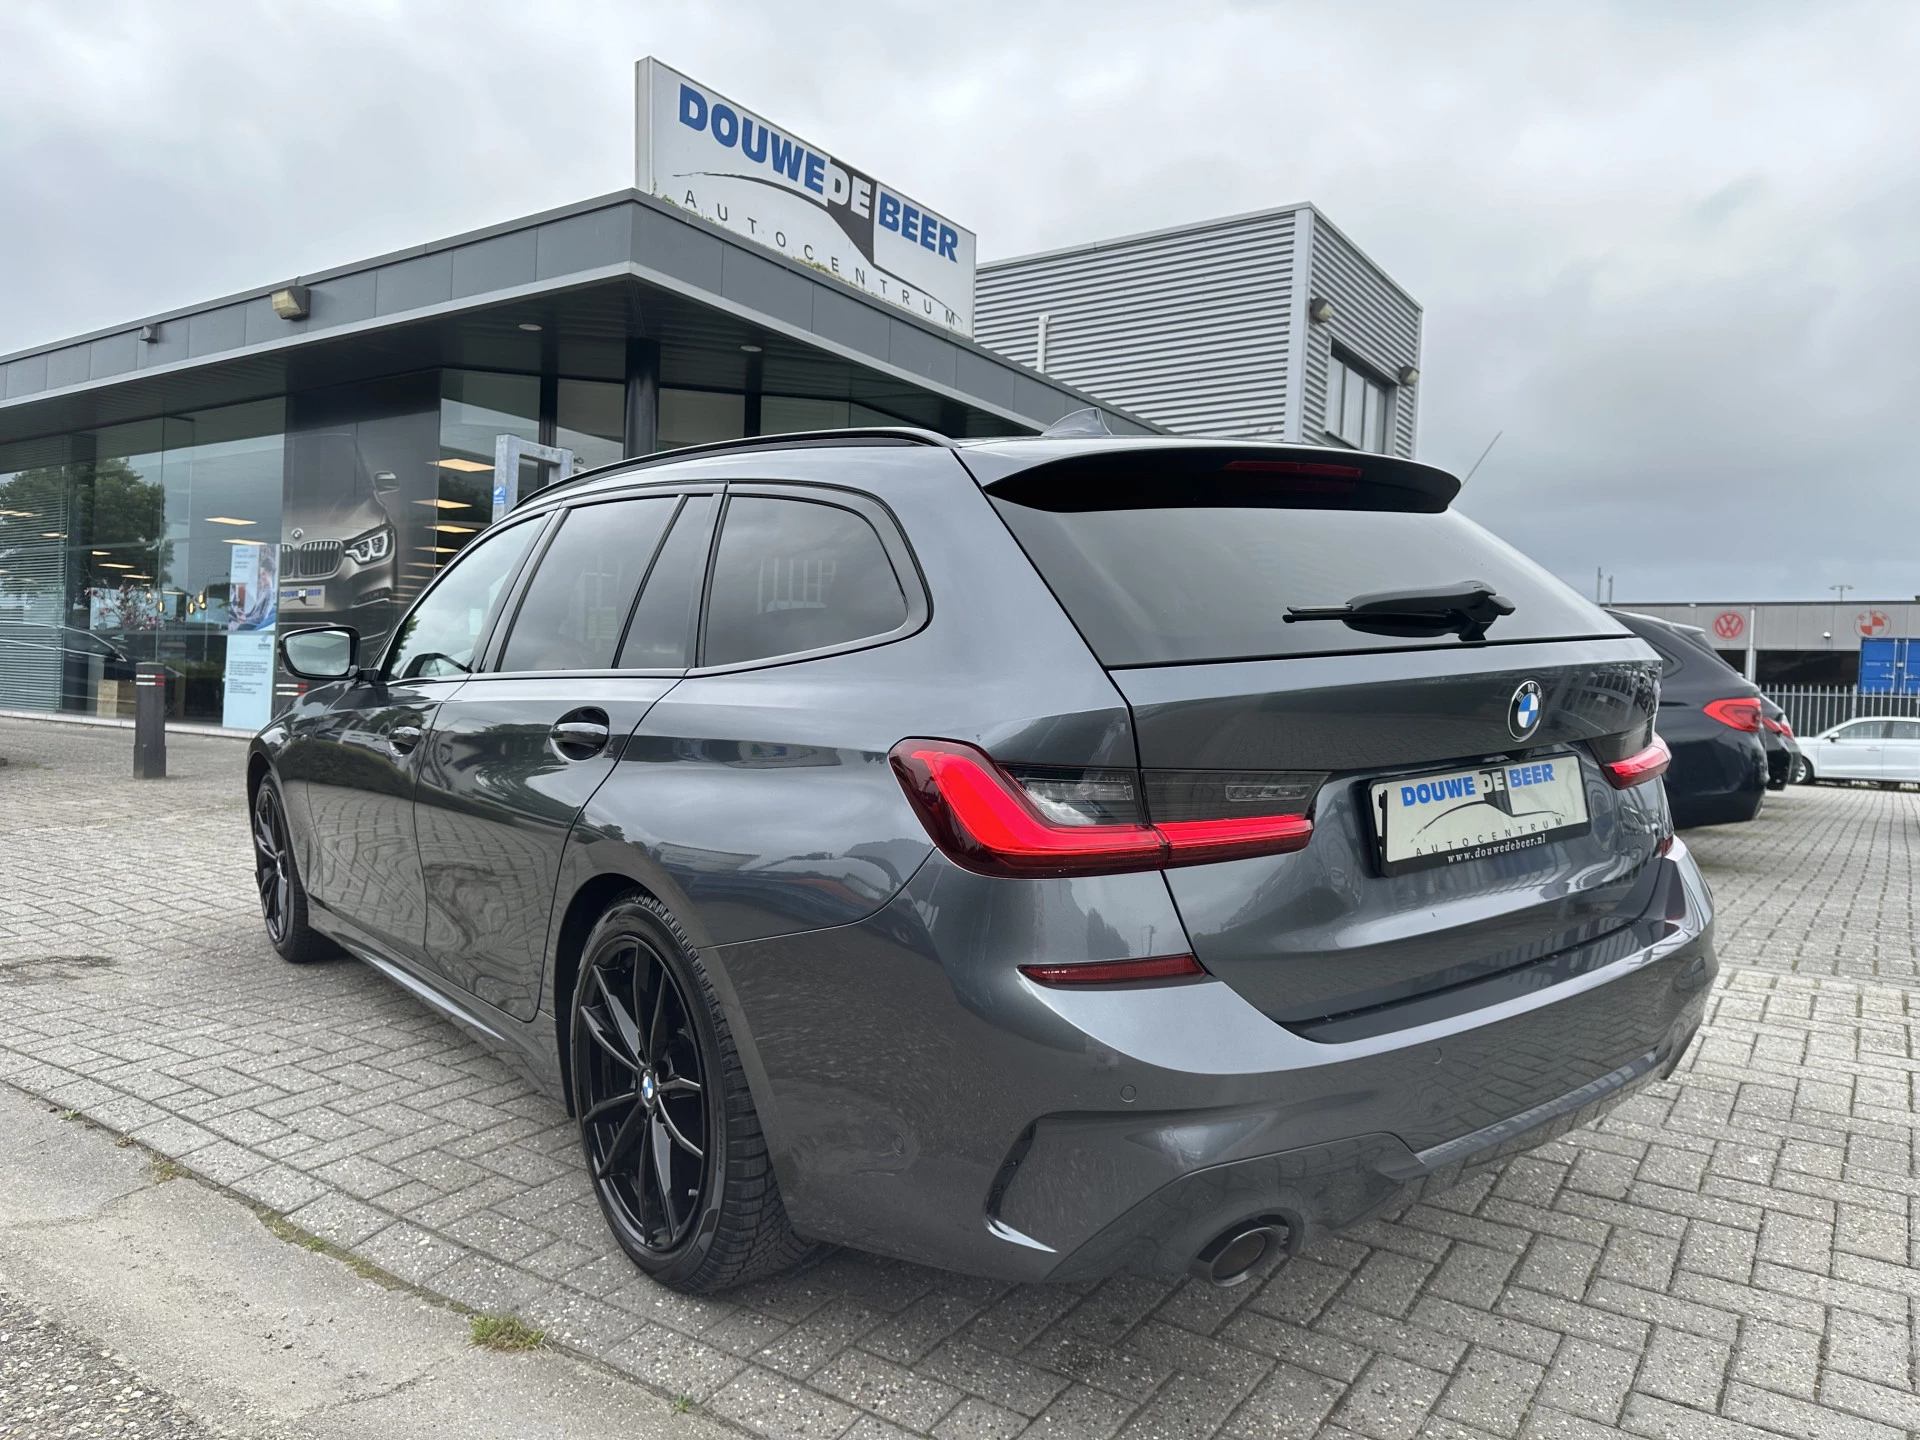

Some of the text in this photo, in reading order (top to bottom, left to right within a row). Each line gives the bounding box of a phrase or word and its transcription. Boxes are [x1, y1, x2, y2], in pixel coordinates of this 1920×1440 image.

[679, 83, 959, 263] DOUWE DE BEER
[1400, 763, 1555, 807] DOUWE DE BEER
[1416, 818, 1563, 857] AUTOCENTRUM
[1447, 833, 1546, 863] www.douwedebeer.nl
